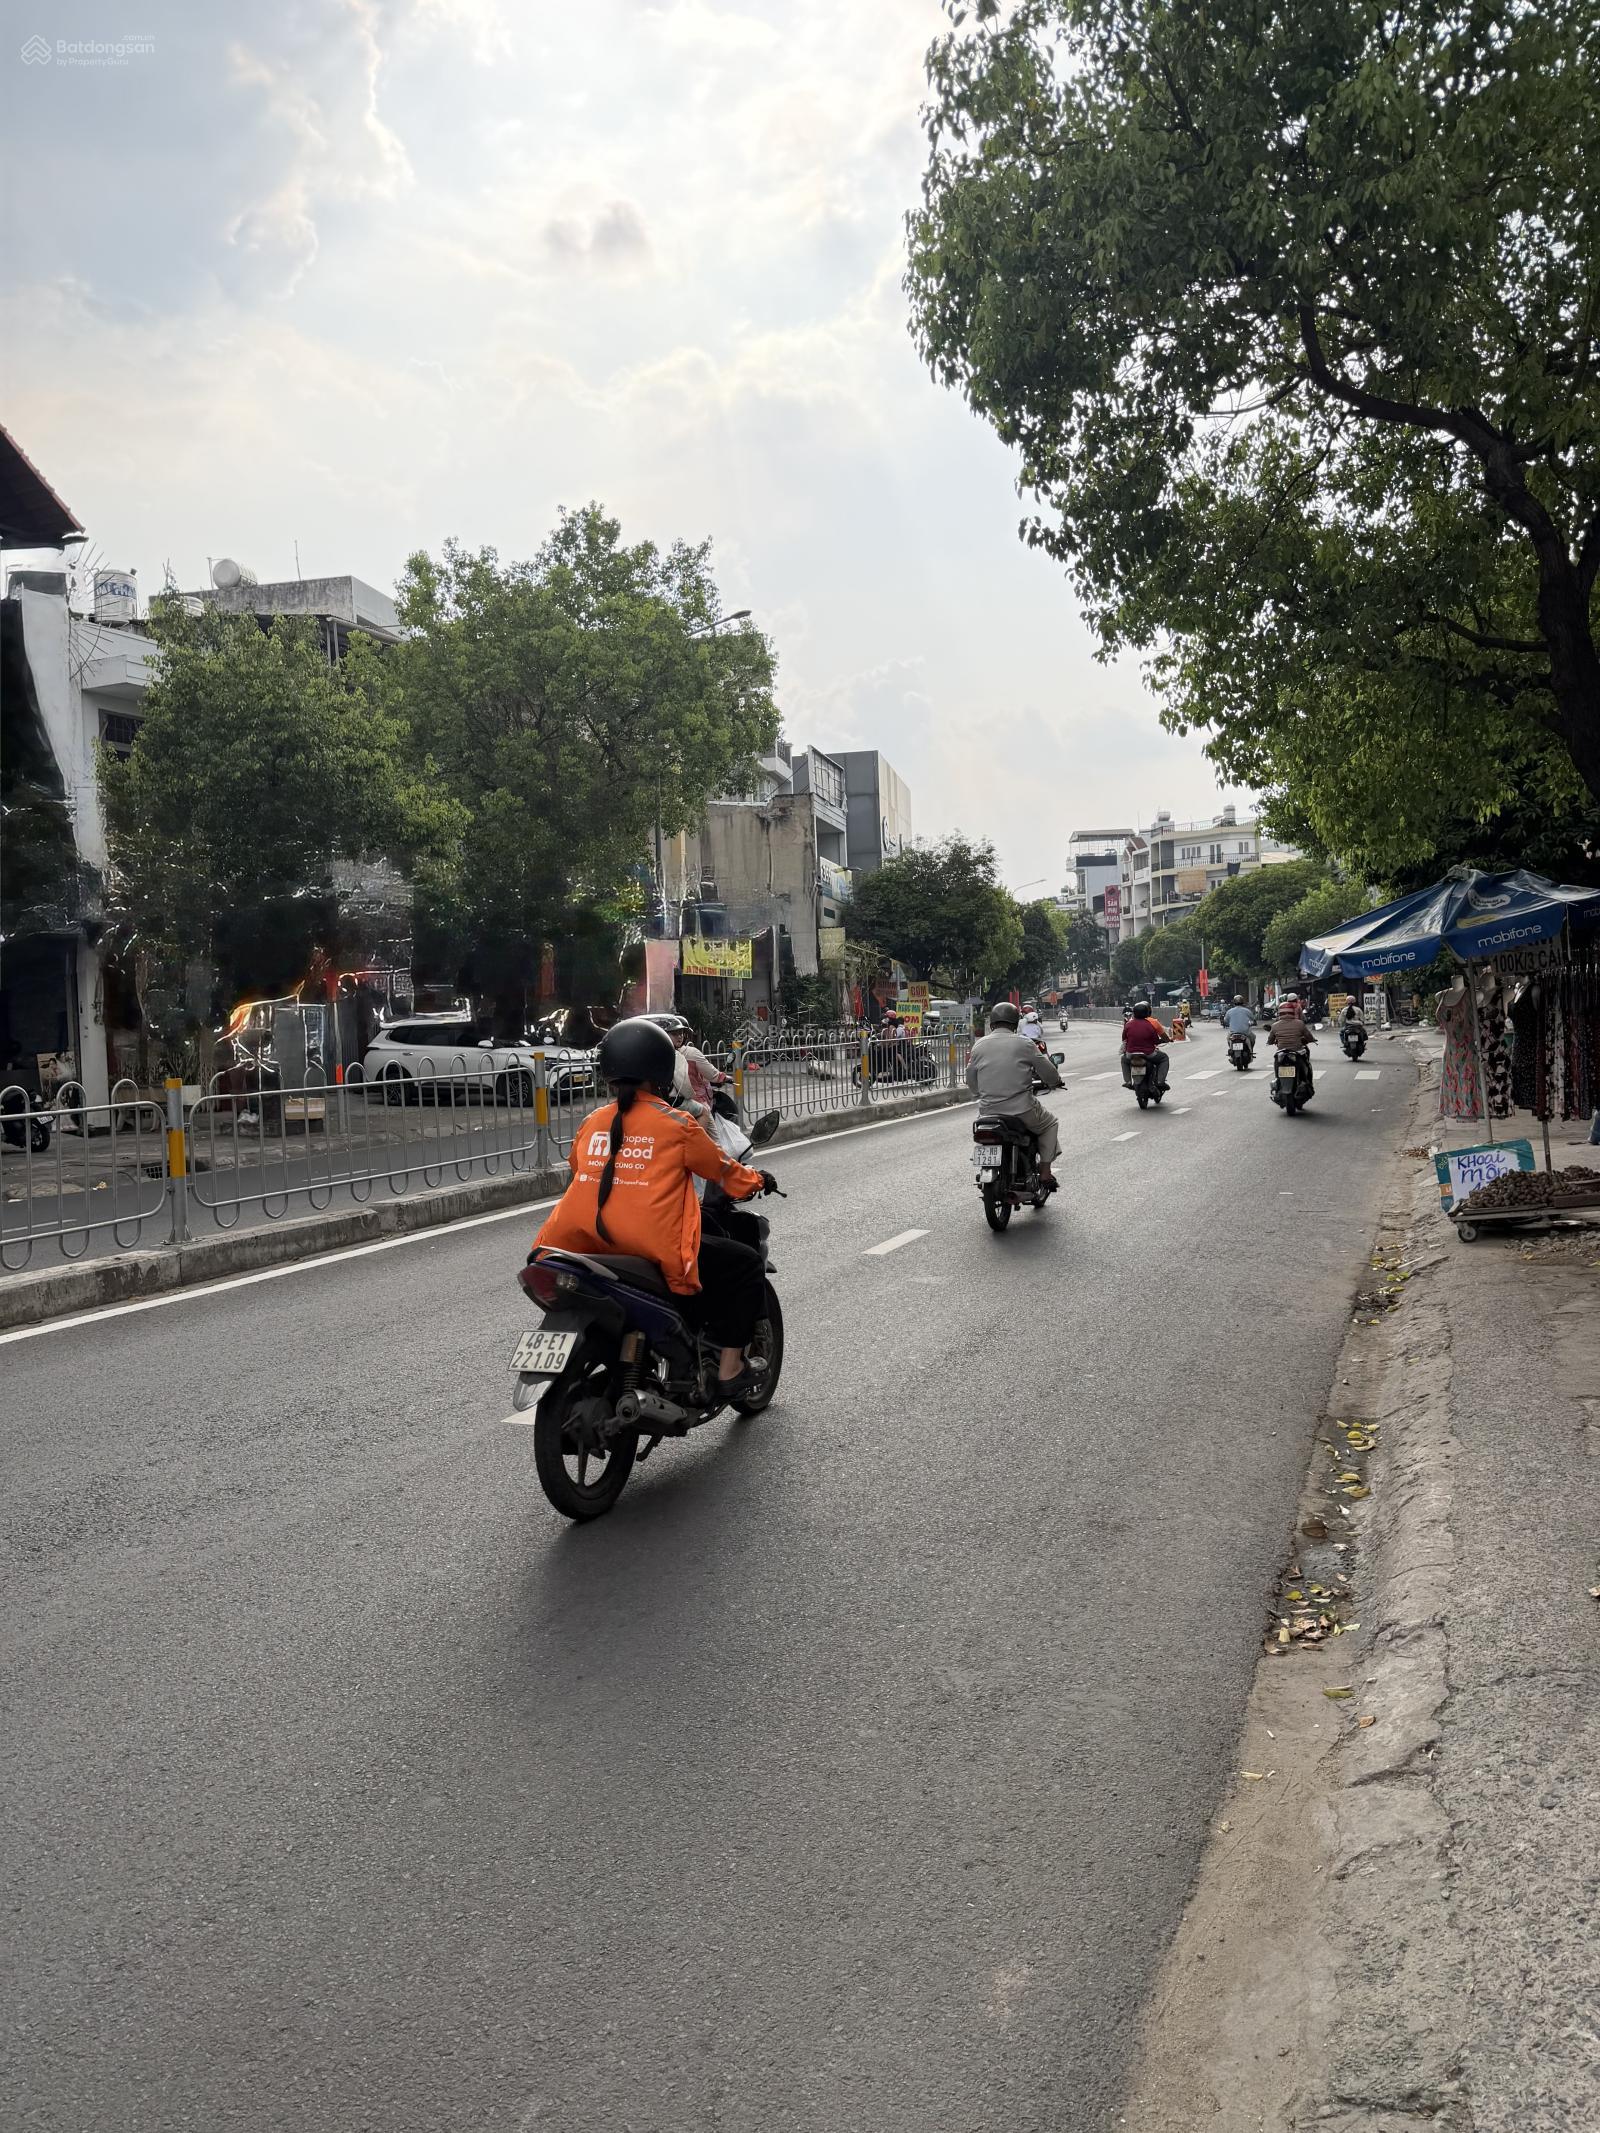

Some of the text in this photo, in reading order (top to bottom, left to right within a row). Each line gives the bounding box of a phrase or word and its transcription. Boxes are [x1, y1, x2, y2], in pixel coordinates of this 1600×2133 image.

[1478, 924, 1543, 948] mobifone
[1361, 951, 1416, 969] mobifone
[1493, 951, 1535, 973] 100K/3
[623, 1132, 655, 1145] hopee
[619, 1144, 653, 1160] ood
[525, 1332, 568, 1351] 48-E1
[511, 1351, 566, 1370] 221.09
